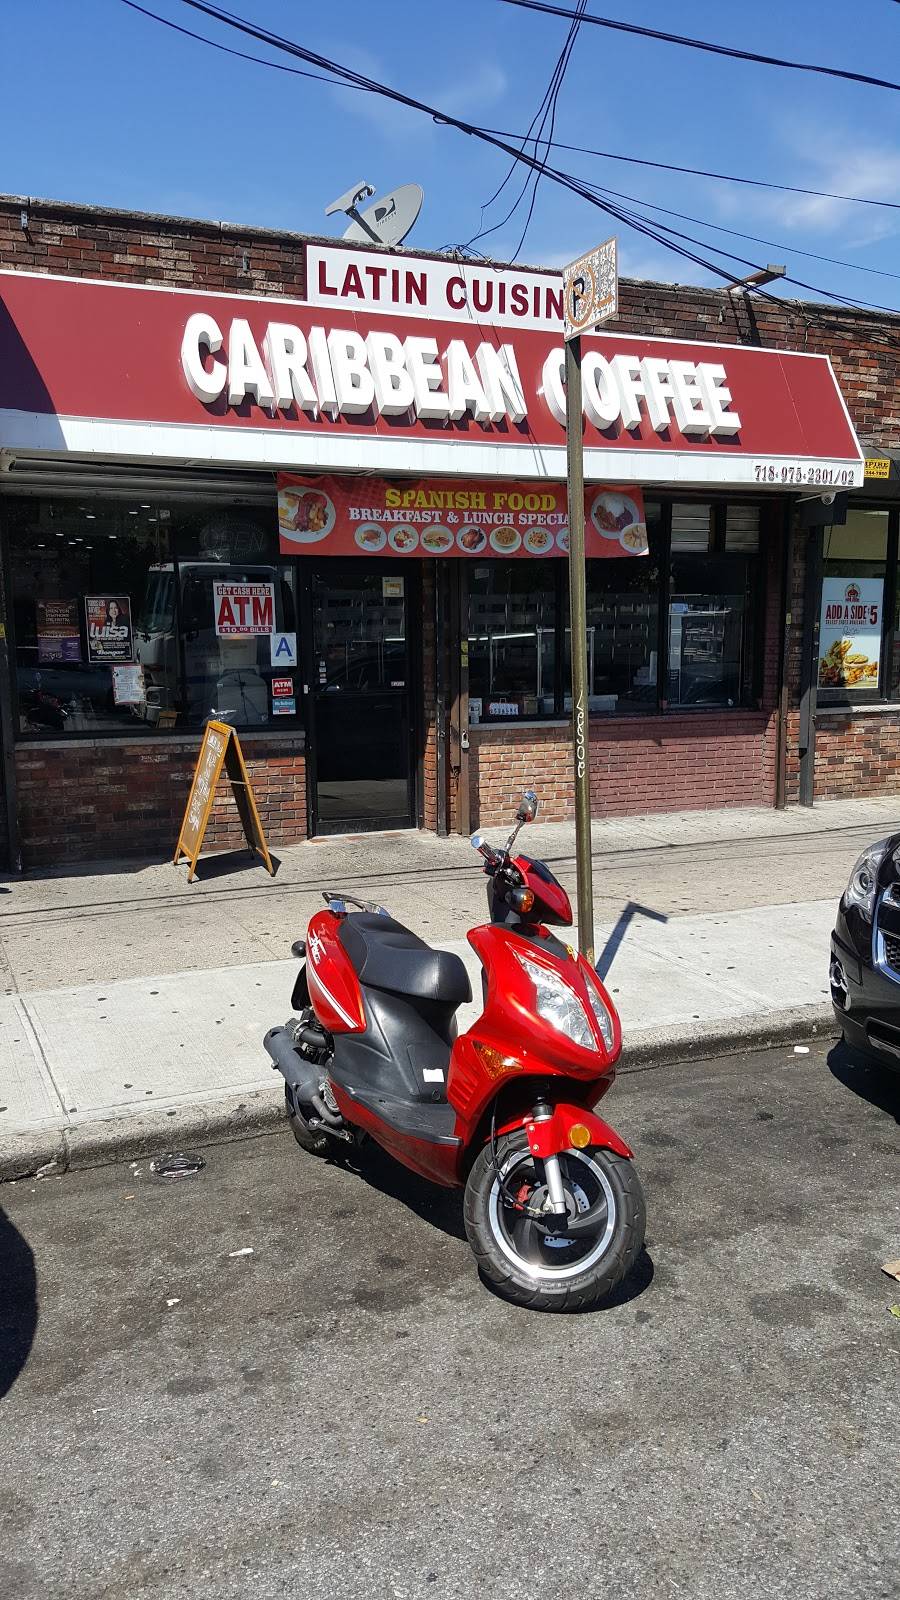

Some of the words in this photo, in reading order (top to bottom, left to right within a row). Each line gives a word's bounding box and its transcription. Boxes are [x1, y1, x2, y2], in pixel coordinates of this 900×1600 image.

[318, 260, 427, 306] LATIN
[445, 276, 564, 321] CUISIN
[181, 312, 528, 424] CARIBBEAN
[541, 347, 742, 437] COFFEE
[385, 488, 486, 509] SPANISH
[493, 493, 556, 512] FOOD
[349, 507, 442, 523] BREAKFAST
[446, 511, 459, 524] &
[463, 511, 515, 525] LUNCH
[218, 587, 232, 595] GET
[233, 587, 250, 595] CASH
[252, 587, 270, 595] HERE
[217, 596, 273, 626] ATM
[826, 605, 842, 620] ADD
[844, 605, 851, 620] A
[851, 605, 867, 620] SIDE
[90, 622, 129, 638] luisa
[275, 637, 293, 657] A
